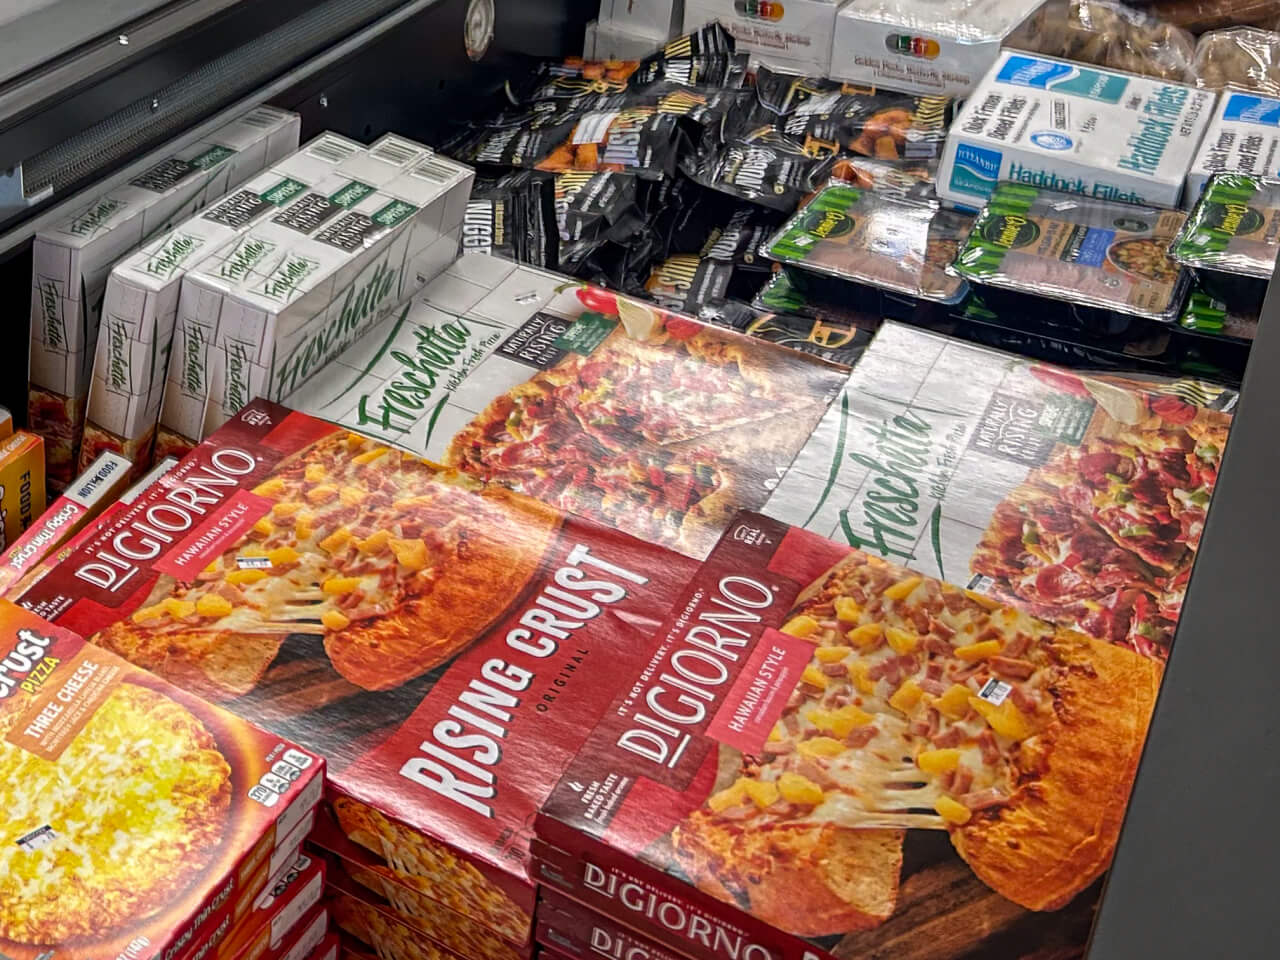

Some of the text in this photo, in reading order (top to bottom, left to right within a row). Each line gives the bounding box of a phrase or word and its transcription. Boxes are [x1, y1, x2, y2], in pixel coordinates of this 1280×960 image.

[977, 93, 1002, 119] Frozen
[1117, 85, 1191, 176] Haddock Fillets
[1009, 161, 1086, 195] Haddock
[219, 195, 263, 228] RISING
[287, 198, 331, 231] RISING
[332, 216, 375, 249] RISING
[147, 232, 194, 279] Freschetta
[220, 237, 269, 283] Freschetta
[265, 254, 311, 301] Freschetta
[276, 265, 397, 384] Freschetta
[502, 315, 545, 356] NATURALLY
[519, 322, 567, 368] RISING
[112, 320, 130, 394] Freschetta
[187, 321, 207, 398] Freschetta
[357, 317, 473, 435] Freschetta
[974, 397, 1009, 450] NATURALLY
[997, 405, 1040, 459] RISING
[77, 460, 119, 501] FOOD LION
[839, 410, 934, 561] Freschetta
[9, 503, 80, 570] Crispy Thin Crust
[75, 447, 258, 592] DIGIORNO
[85, 539, 101, 555] IT'S
[100, 527, 117, 543] NOT
[173, 522, 224, 567] HAWAIIAN
[221, 501, 250, 530] STYLE
[20, 654, 61, 695] PIZZA
[398, 542, 650, 820] RISING CRUST
[536, 648, 590, 713] ORIGINAL
[618, 575, 774, 768] DIGIORNO
[618, 698, 631, 717] IT'S
[628, 682, 643, 703] NOT
[665, 627, 680, 647] IT'S
[727, 645, 787, 733] HAWAIIAN STYLE
[23, 698, 64, 739] THREE
[58, 659, 100, 703] CHEESE
[250, 784, 269, 802] 370
[580, 779, 601, 805] FRESH
[583, 773, 619, 820] BAKED TASTE
[583, 861, 771, 960] DIGIORNO
